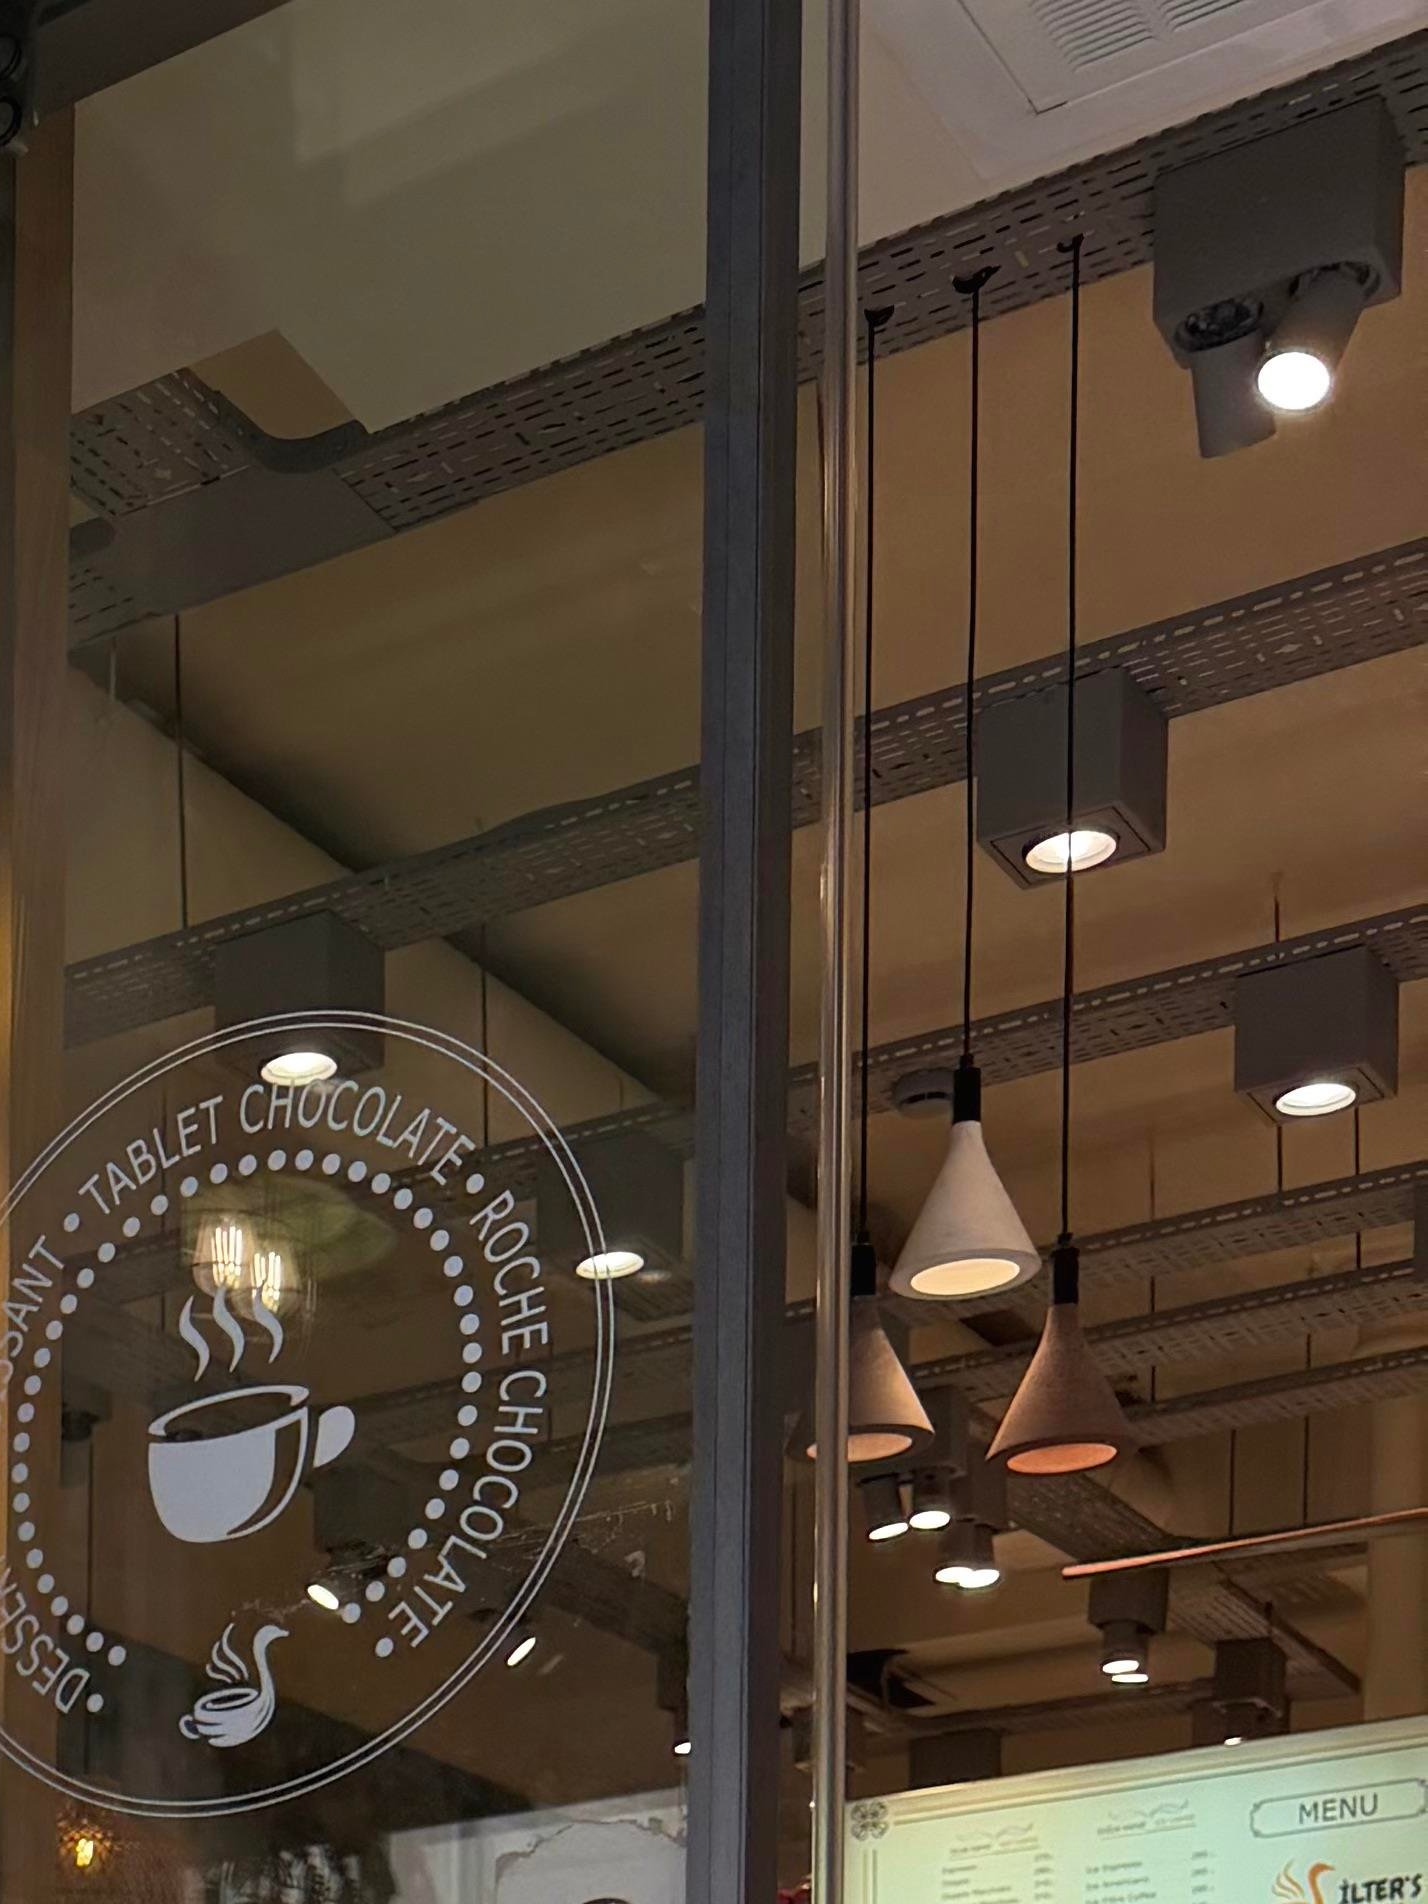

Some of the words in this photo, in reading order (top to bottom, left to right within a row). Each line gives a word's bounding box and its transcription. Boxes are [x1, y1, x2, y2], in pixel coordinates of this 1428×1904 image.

[77, 1095, 224, 1214] TABLET
[240, 1077, 476, 1186] CHOCOLATE
[469, 1189, 549, 1355] ROCHE
[387, 1370, 547, 1648] CHOCOLATE
[1298, 1793, 1379, 1825] MENU
